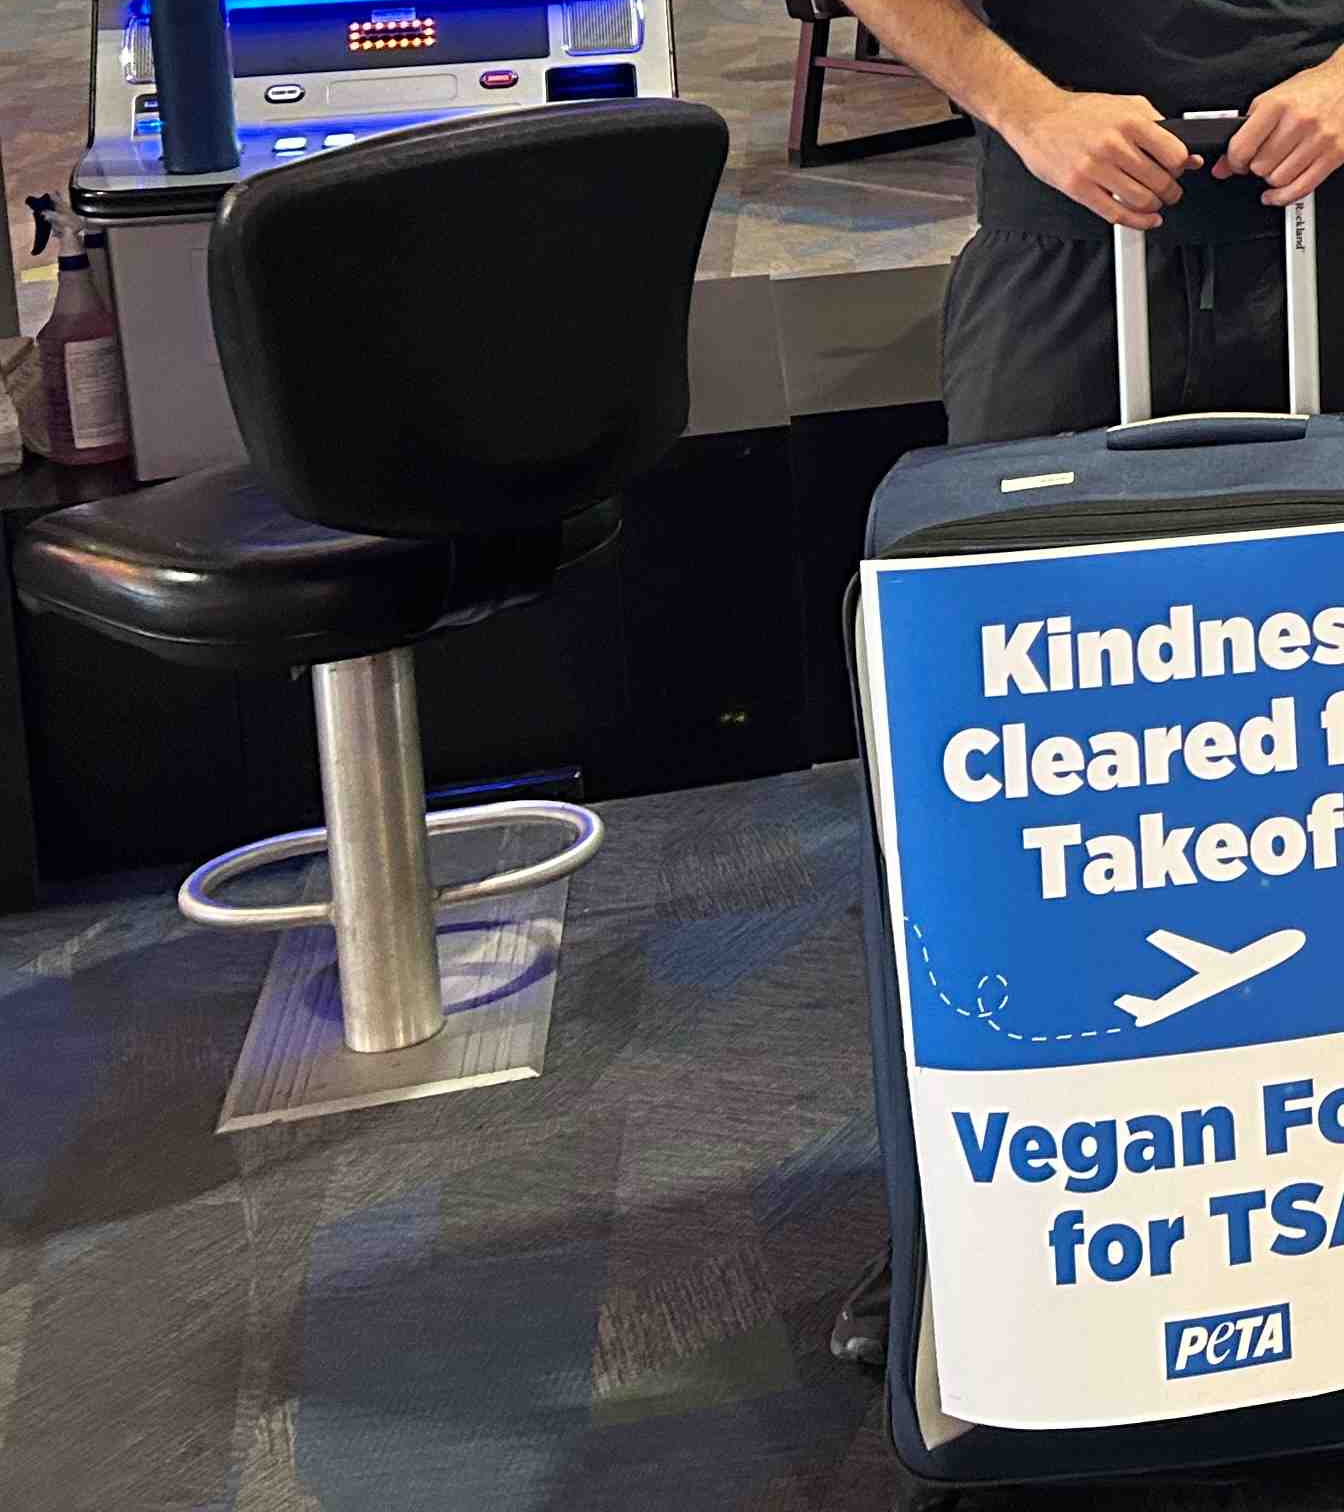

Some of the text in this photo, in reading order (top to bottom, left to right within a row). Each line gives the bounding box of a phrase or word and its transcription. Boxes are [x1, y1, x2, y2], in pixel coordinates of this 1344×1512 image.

[943, 696, 1298, 803] Cleared
[953, 1106, 1236, 1193] Vegan
[1049, 1210, 1185, 1286] for
[1175, 1312, 1285, 1370] PeTA
